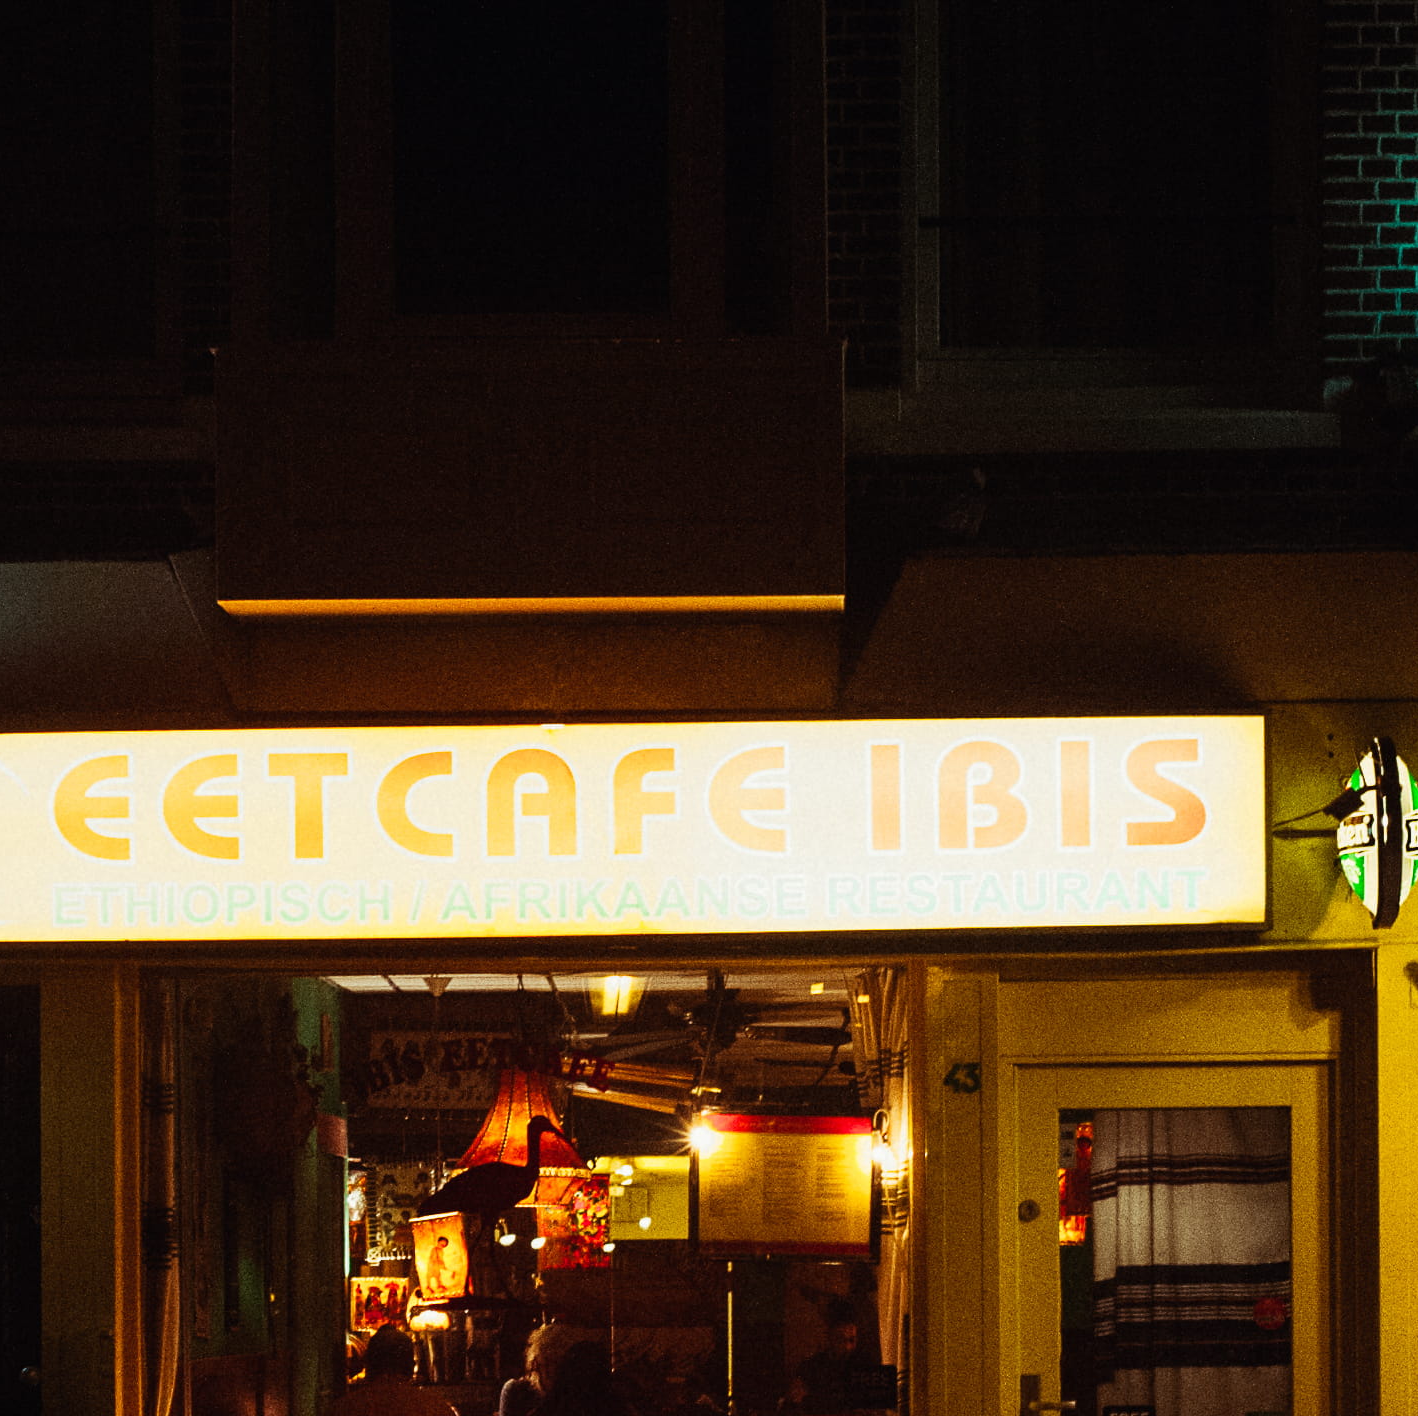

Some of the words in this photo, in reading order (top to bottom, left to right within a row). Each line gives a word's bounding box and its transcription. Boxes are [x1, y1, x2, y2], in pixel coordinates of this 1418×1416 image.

[51, 743, 788, 862] EETCAFE
[869, 737, 1208, 851] IBIS
[52, 883, 391, 926] ETHIOPISCH
[441, 874, 807, 922] AFRIKAANSE
[827, 869, 1208, 917] RESTAURANT
[944, 1063, 981, 1093] 43
